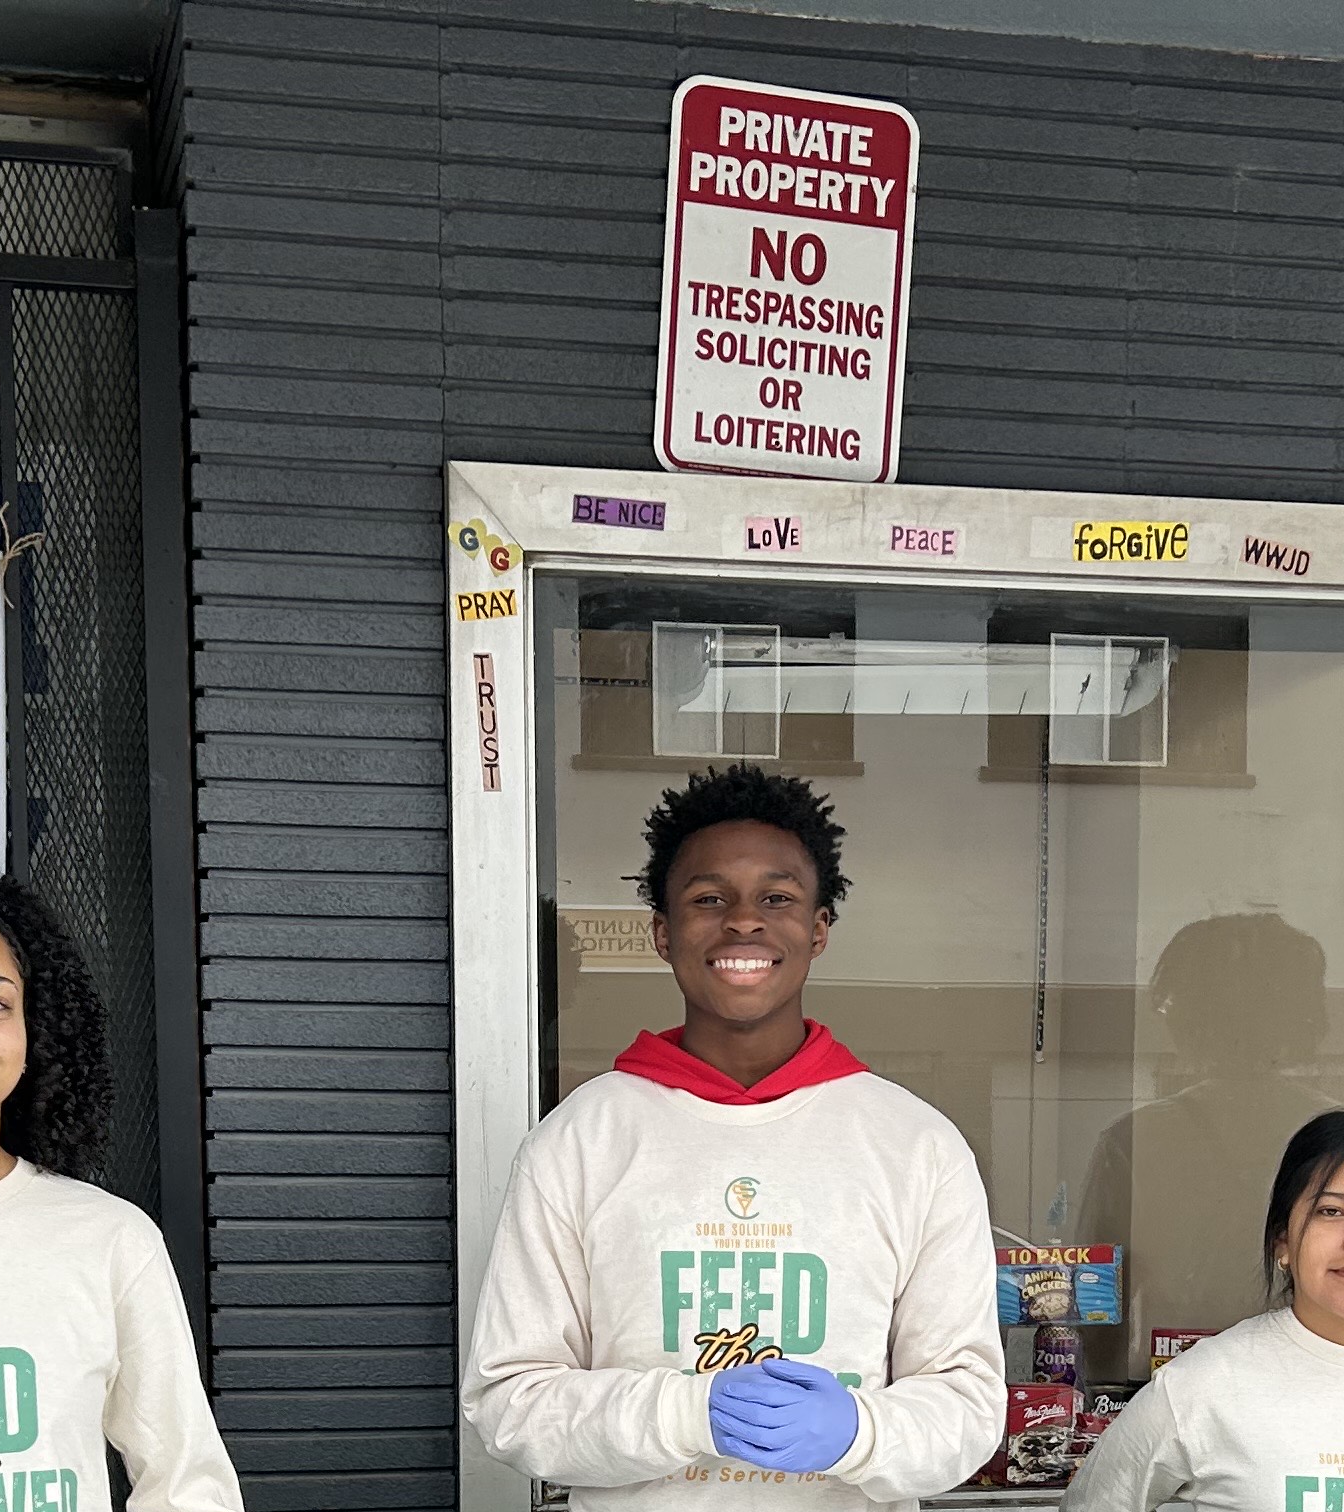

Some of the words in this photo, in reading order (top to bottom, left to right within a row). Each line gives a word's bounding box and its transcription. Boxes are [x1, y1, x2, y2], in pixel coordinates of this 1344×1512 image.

[718, 106, 873, 168] PRIVATE
[689, 151, 896, 218] PROPERTY
[749, 226, 828, 286] NO
[687, 280, 885, 340] TRESPASSING
[694, 328, 871, 381] SOLICITING
[758, 376, 803, 412] OR
[693, 411, 861, 462] LOITERING
[574, 494, 609, 524] BE
[618, 501, 664, 527] NICE
[459, 527, 480, 552] G
[1242, 536, 1311, 577] WWJD
[490, 547, 510, 571] G
[457, 589, 516, 621] PRAY
[474, 654, 500, 790] TRUST
[696, 1222, 726, 1237] SOAR
[731, 1223, 793, 1237] SOLUTIONS
[1007, 1248, 1032, 1265] 10
[1036, 1247, 1091, 1264] PACK
[1024, 1270, 1068, 1285] ANIMAL
[660, 1250, 828, 1355] FEED
[684, 1465, 710, 1481] Us
[719, 1467, 786, 1484] Serve
